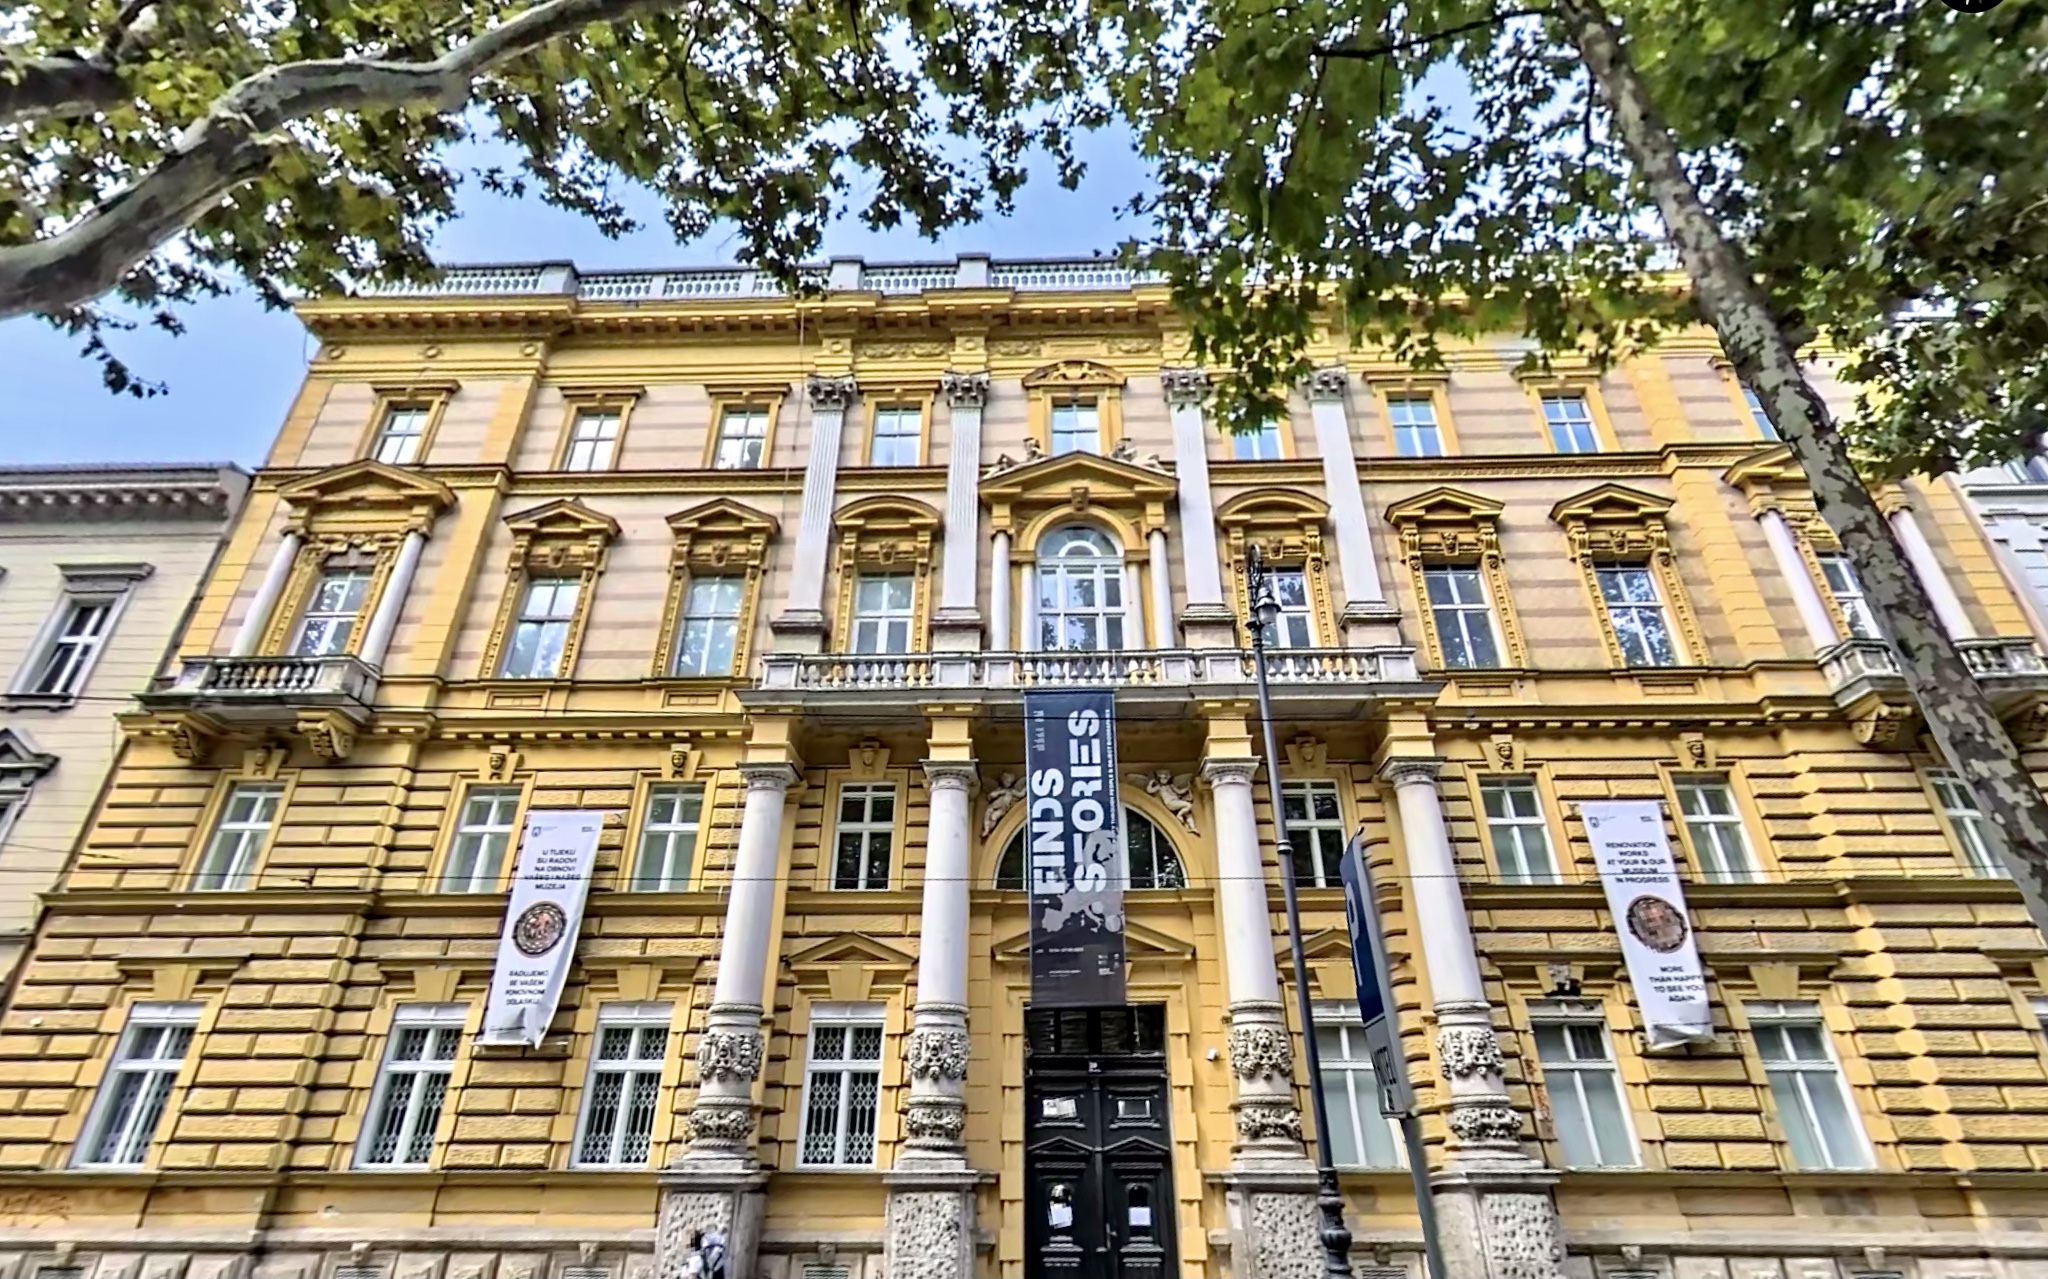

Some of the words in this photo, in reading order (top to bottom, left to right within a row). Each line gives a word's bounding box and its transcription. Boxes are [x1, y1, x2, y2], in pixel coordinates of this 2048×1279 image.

[1031, 767, 1065, 896] FINDS
[1067, 709, 1107, 894] STORIES
[1345, 880, 1363, 987] P
